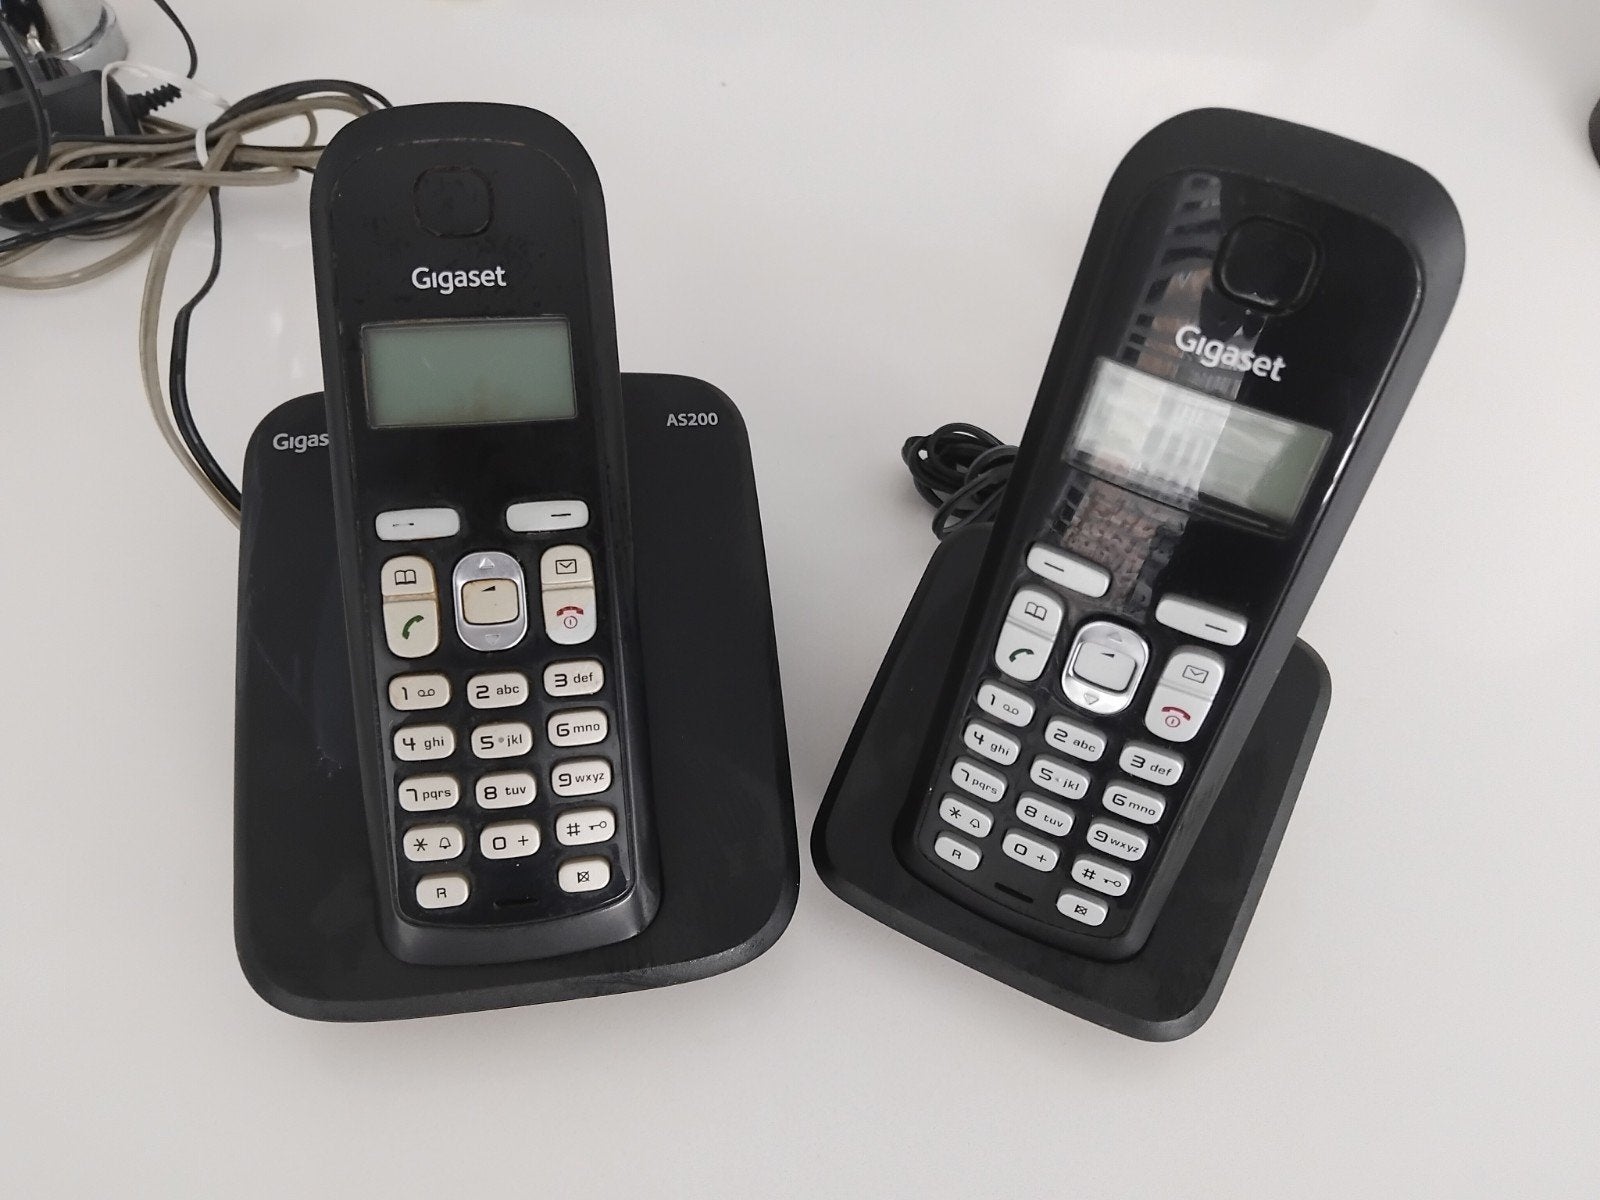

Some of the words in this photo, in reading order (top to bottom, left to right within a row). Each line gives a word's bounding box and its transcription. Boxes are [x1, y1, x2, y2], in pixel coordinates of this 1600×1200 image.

[411, 265, 507, 294] Gigaset
[1175, 325, 1286, 381] Gigaset
[666, 411, 719, 427] AS200
[273, 432, 329, 453] Gigas
[554, 673, 568, 688] 3
[573, 672, 595, 684] def
[401, 686, 409, 700] 1
[475, 684, 490, 700] 2
[496, 684, 520, 696] abc
[989, 693, 996, 706] 1
[556, 722, 570, 737] 6
[573, 723, 601, 733] mno
[402, 737, 416, 751] 4
[423, 737, 445, 750] ghi
[480, 735, 495, 750] 5
[506, 733, 523, 747] jkl
[973, 730, 985, 745] 4
[989, 740, 1011, 757] ghi
[1053, 727, 1069, 743] 2
[1073, 737, 1096, 752] abc
[1130, 754, 1146, 769] 3
[1149, 762, 1173, 776] def
[558, 773, 572, 788] 9
[575, 771, 605, 784] wxyz
[960, 768, 970, 782] 7
[971, 778, 998, 795] pqrs
[1038, 767, 1053, 781] 5
[1062, 777, 1080, 791] jkl
[406, 788, 418, 802] 7
[422, 788, 451, 800] pqrs
[484, 786, 498, 800] 8
[504, 785, 527, 796] tuv
[1112, 793, 1128, 806] 6
[1128, 800, 1156, 816] mno
[1024, 805, 1038, 818] 8
[1043, 813, 1064, 828] tuv
[566, 822, 581, 837] #
[492, 836, 507, 851] 0
[518, 835, 529, 846] +
[1093, 829, 1109, 843] 9
[1109, 838, 1140, 853] wxyz
[951, 848, 963, 860] R
[1013, 843, 1028, 856] 0
[1036, 853, 1047, 863] +
[1081, 867, 1096, 880] #
[436, 888, 447, 899] R
